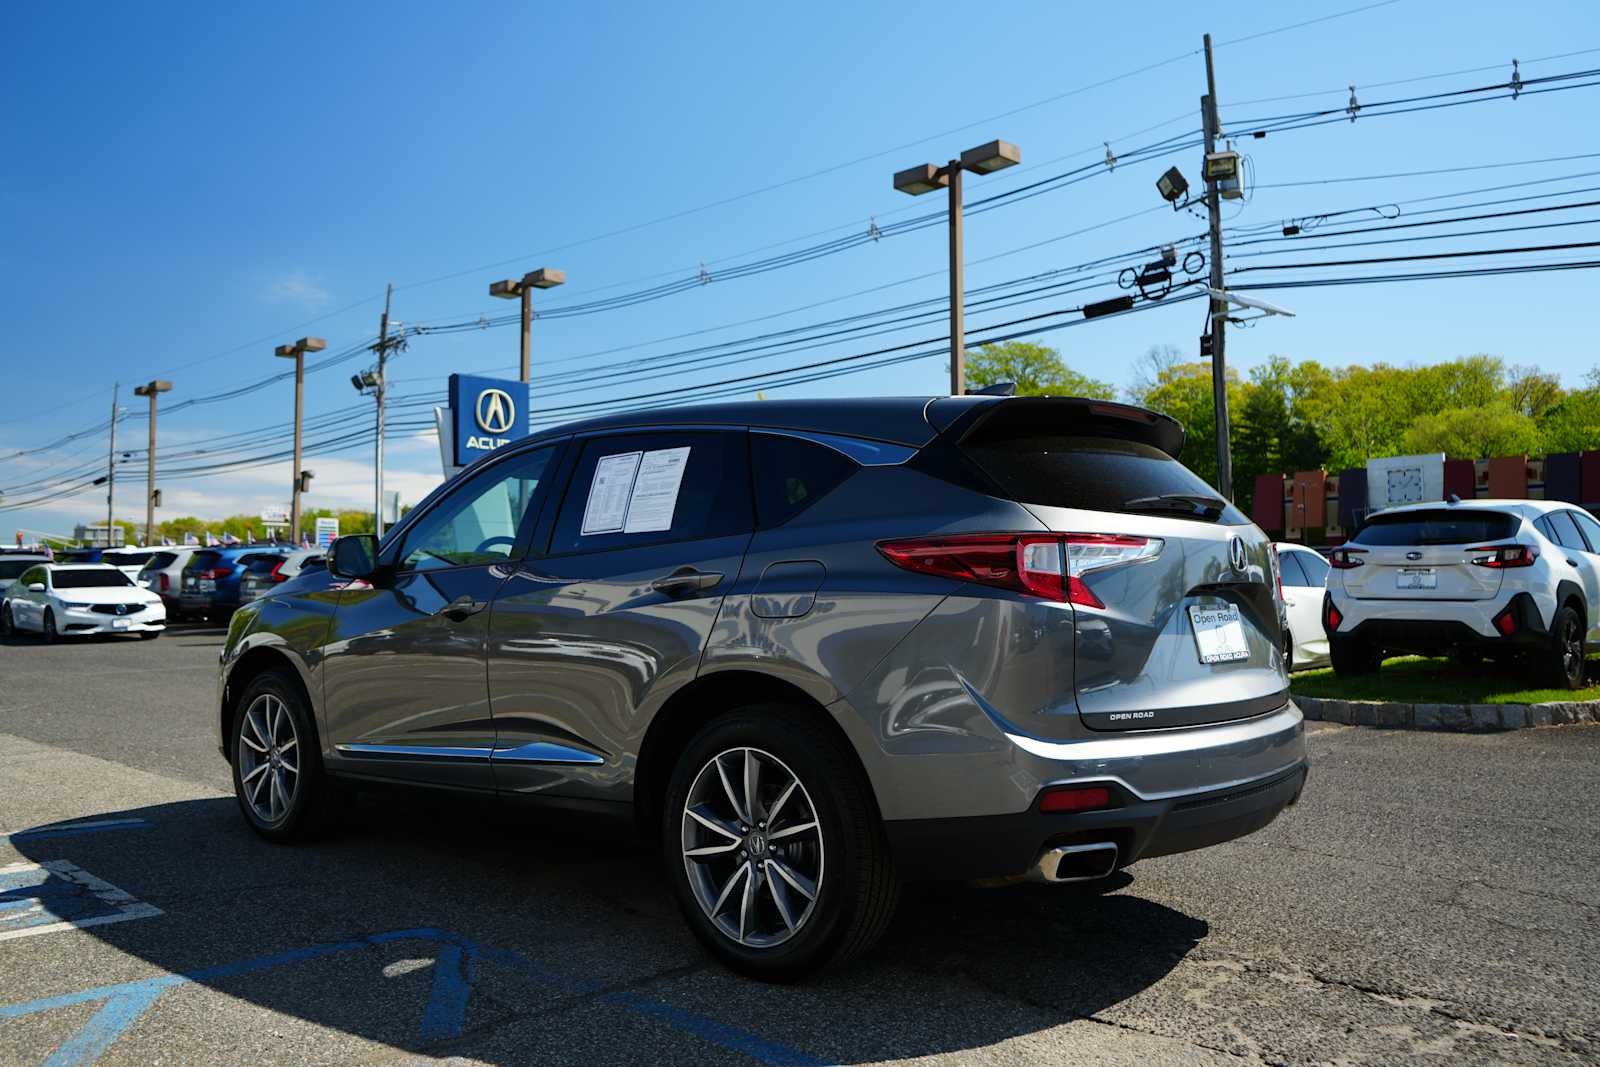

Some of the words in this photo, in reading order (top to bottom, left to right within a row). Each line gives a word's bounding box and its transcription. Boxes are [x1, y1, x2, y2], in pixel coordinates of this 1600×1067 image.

[1194, 614, 1215, 624] Open
[1217, 612, 1238, 622] Road
[1132, 711, 1154, 719] ROAD
